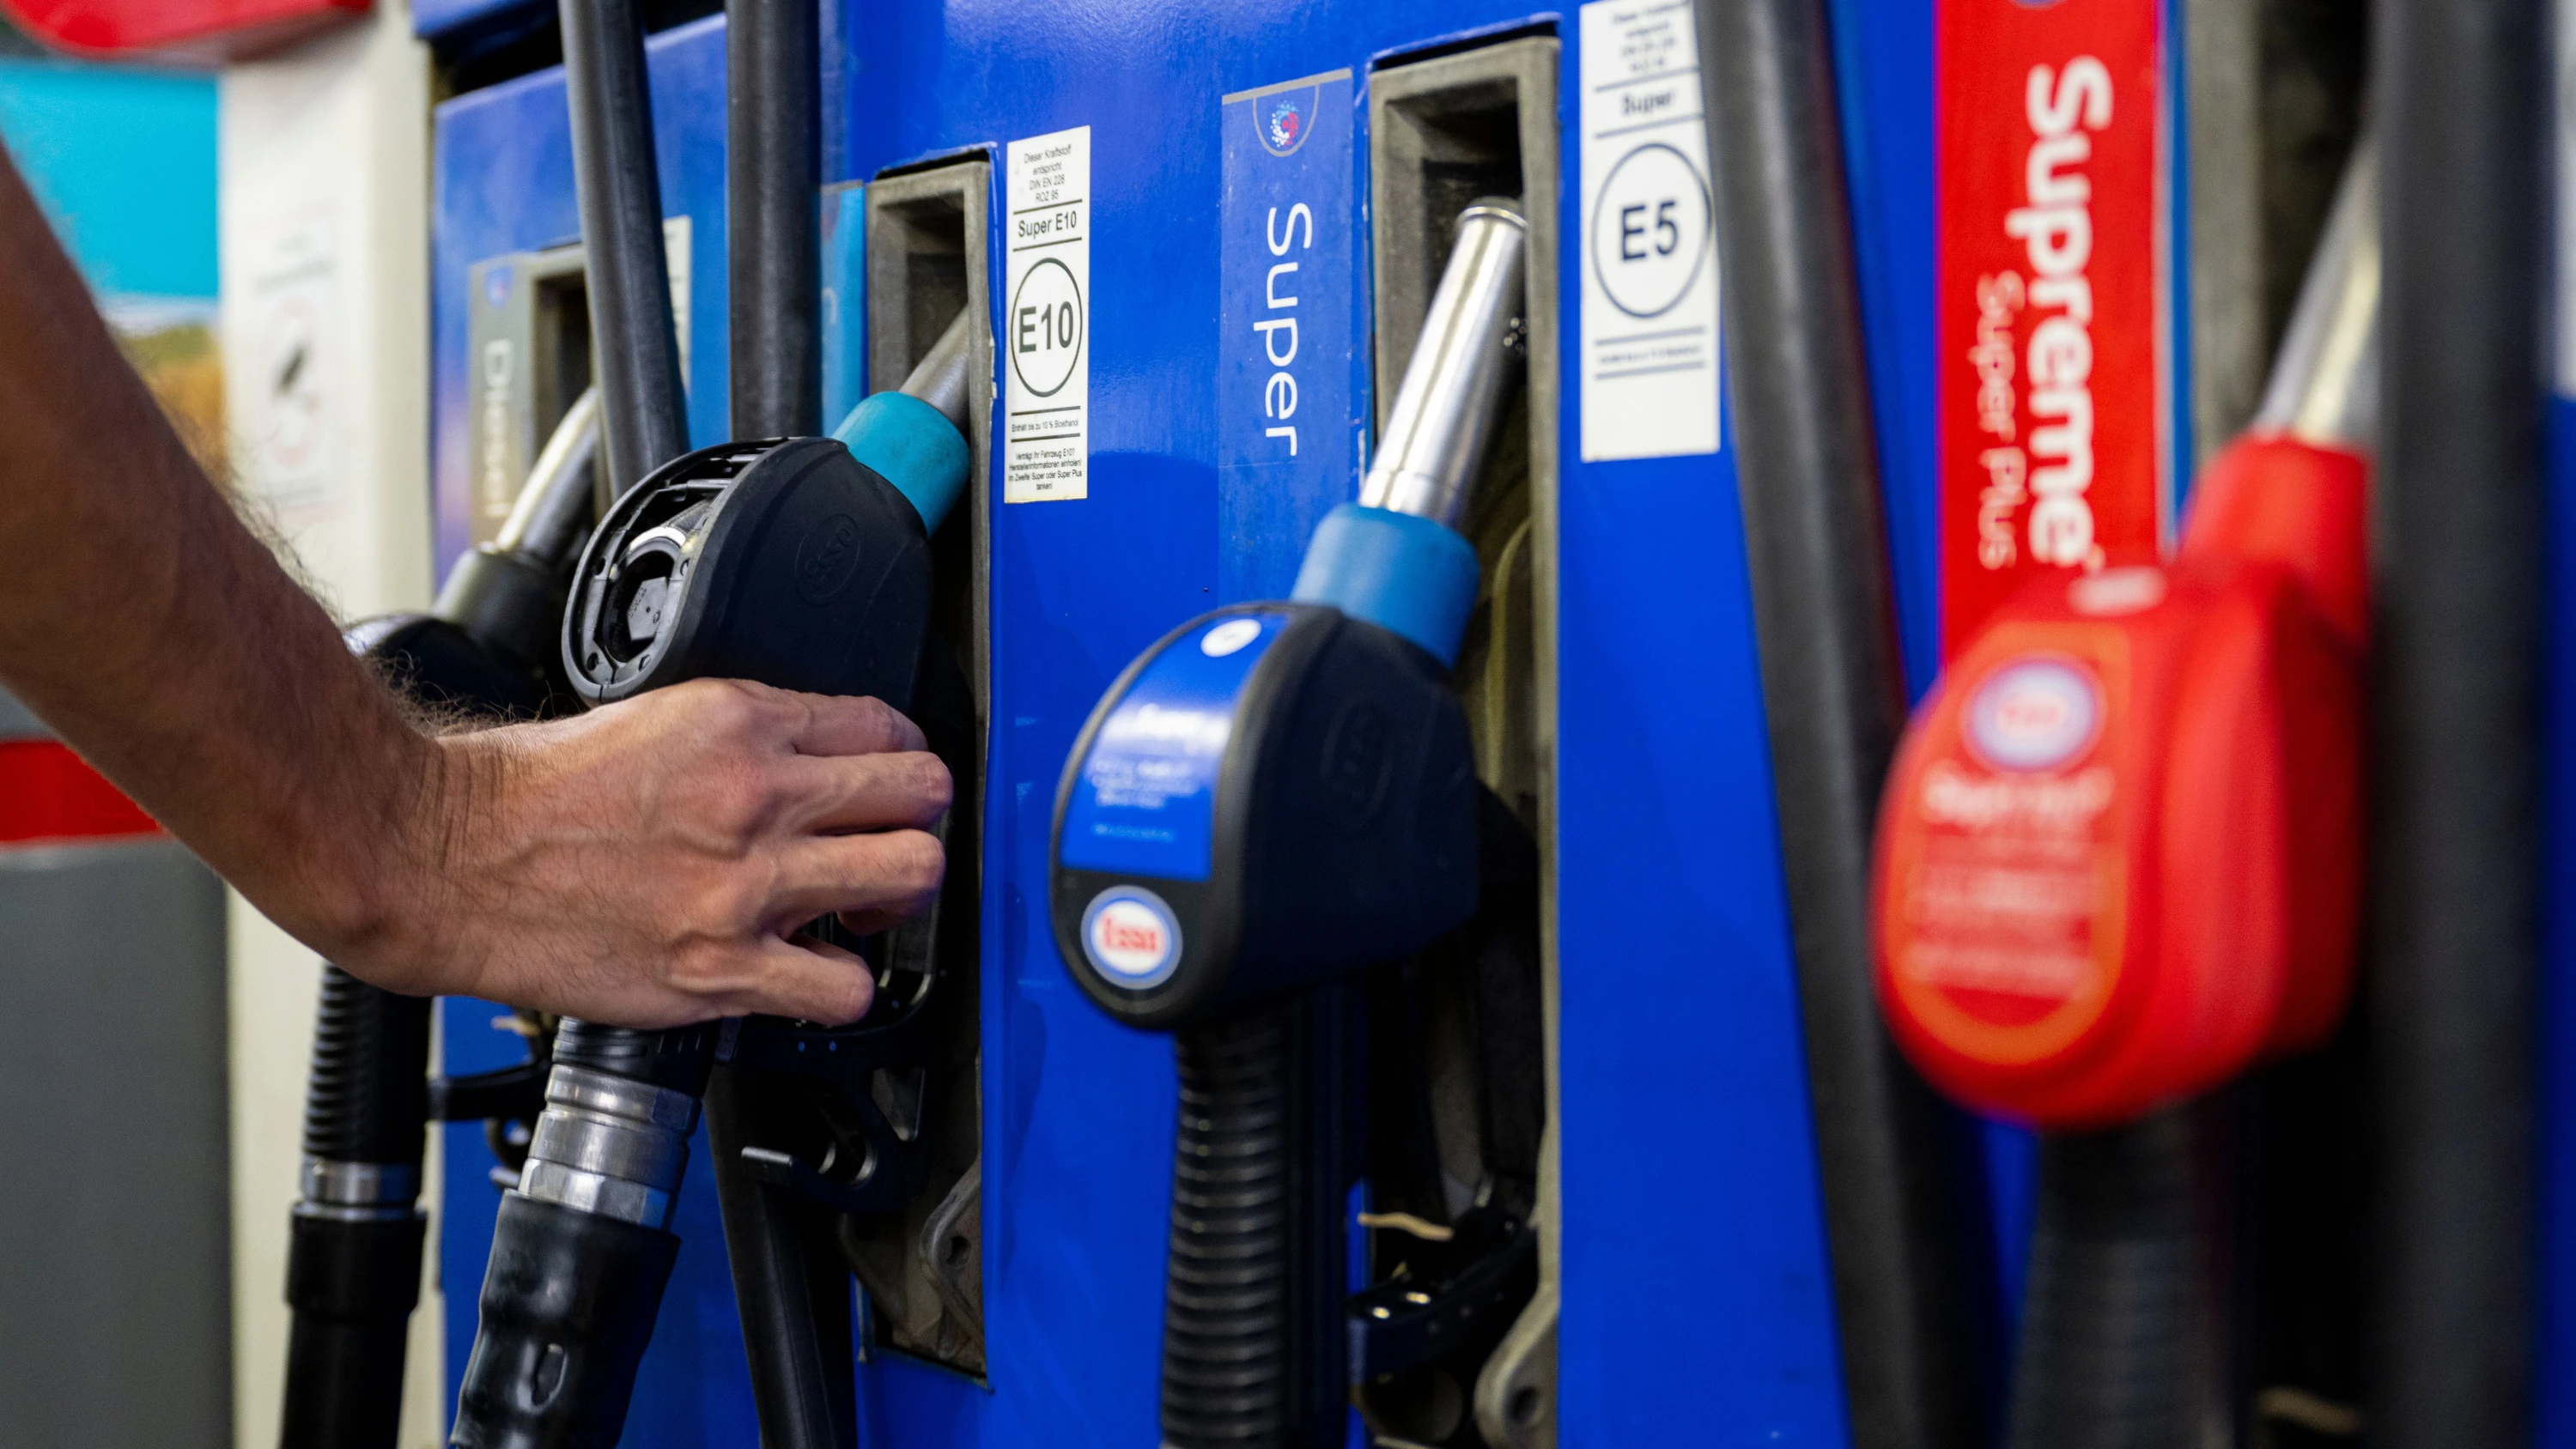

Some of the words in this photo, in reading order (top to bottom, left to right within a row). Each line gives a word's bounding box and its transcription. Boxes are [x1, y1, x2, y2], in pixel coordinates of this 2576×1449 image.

[1030, 179, 1041, 190] DIN
[1042, 177, 1052, 187] EN
[1018, 219, 1052, 239] Super
[1056, 210, 1077, 231] E10
[1621, 198, 1678, 263] E5
[1019, 301, 1073, 353] E10
[1254, 203, 1313, 456] Super
[2006, 55, 2113, 566] Supreme
[1968, 270, 2026, 442] Super
[1031, 472, 1045, 481] Super
[1057, 470, 1071, 480] Super
[1072, 469, 1082, 477] Plus
[1978, 446, 2027, 569] Plus
